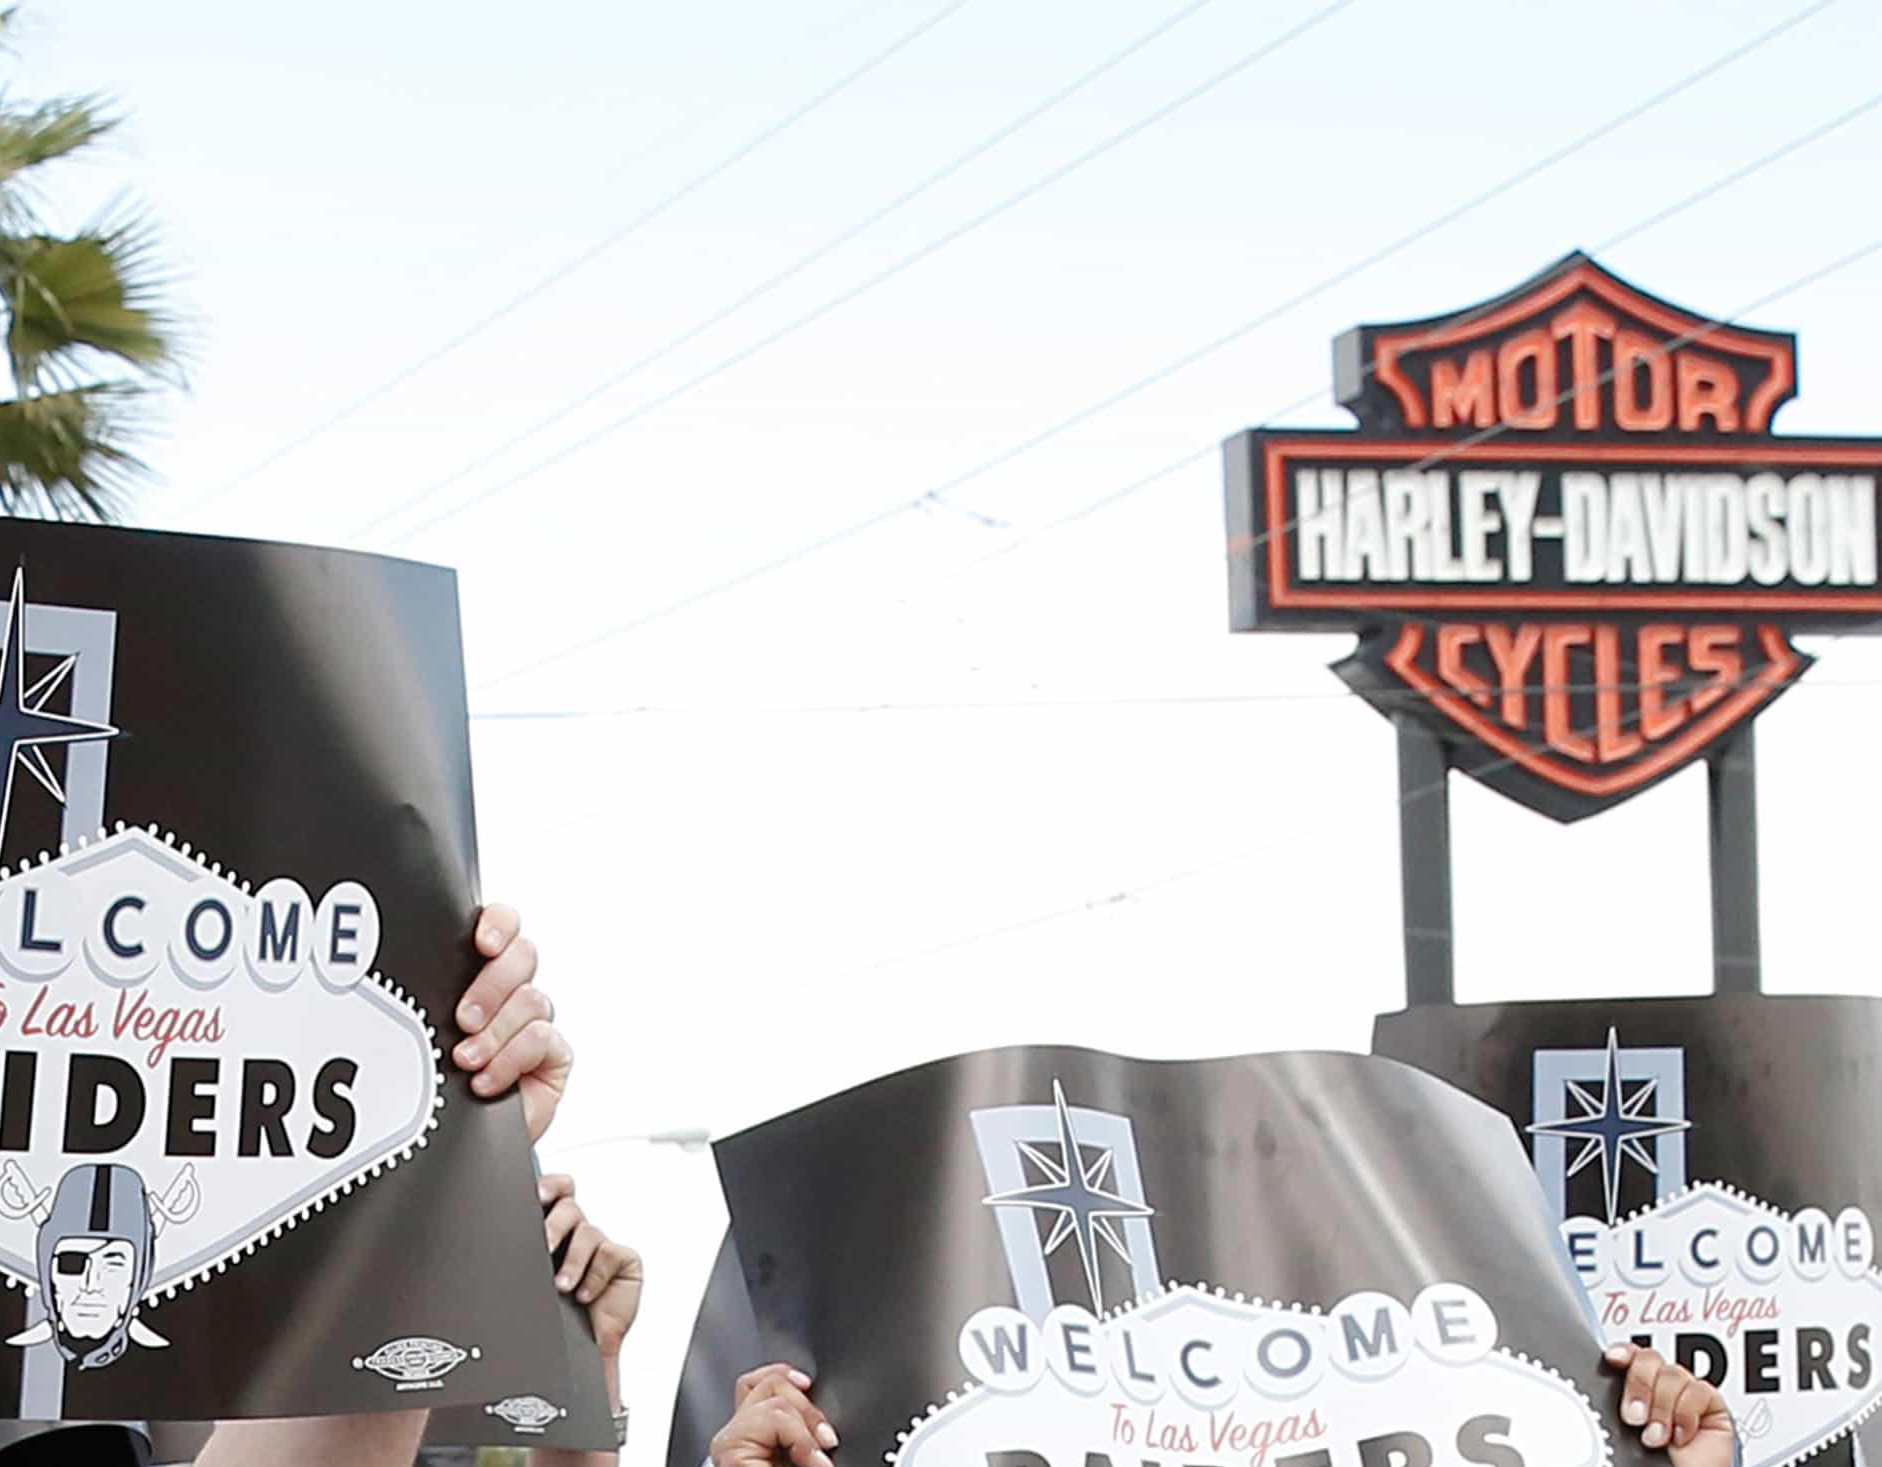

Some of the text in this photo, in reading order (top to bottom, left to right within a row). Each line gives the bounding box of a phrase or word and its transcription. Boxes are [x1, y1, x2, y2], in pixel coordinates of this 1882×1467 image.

[1430, 301, 1742, 432] MOTOR
[1295, 468, 1880, 586] HARLEY-DAVIDSON
[1436, 624, 1744, 763] CYCLES
[22, 984, 95, 1041] Las
[113, 987, 225, 1068] Vegas
[970, 1299, 1483, 1388] WELCOME
[1601, 1288, 1780, 1338] To Las Vegas
[1630, 1323, 1873, 1395] DERS
[1110, 1403, 1134, 1444] To
[1145, 1406, 1198, 1454] Las
